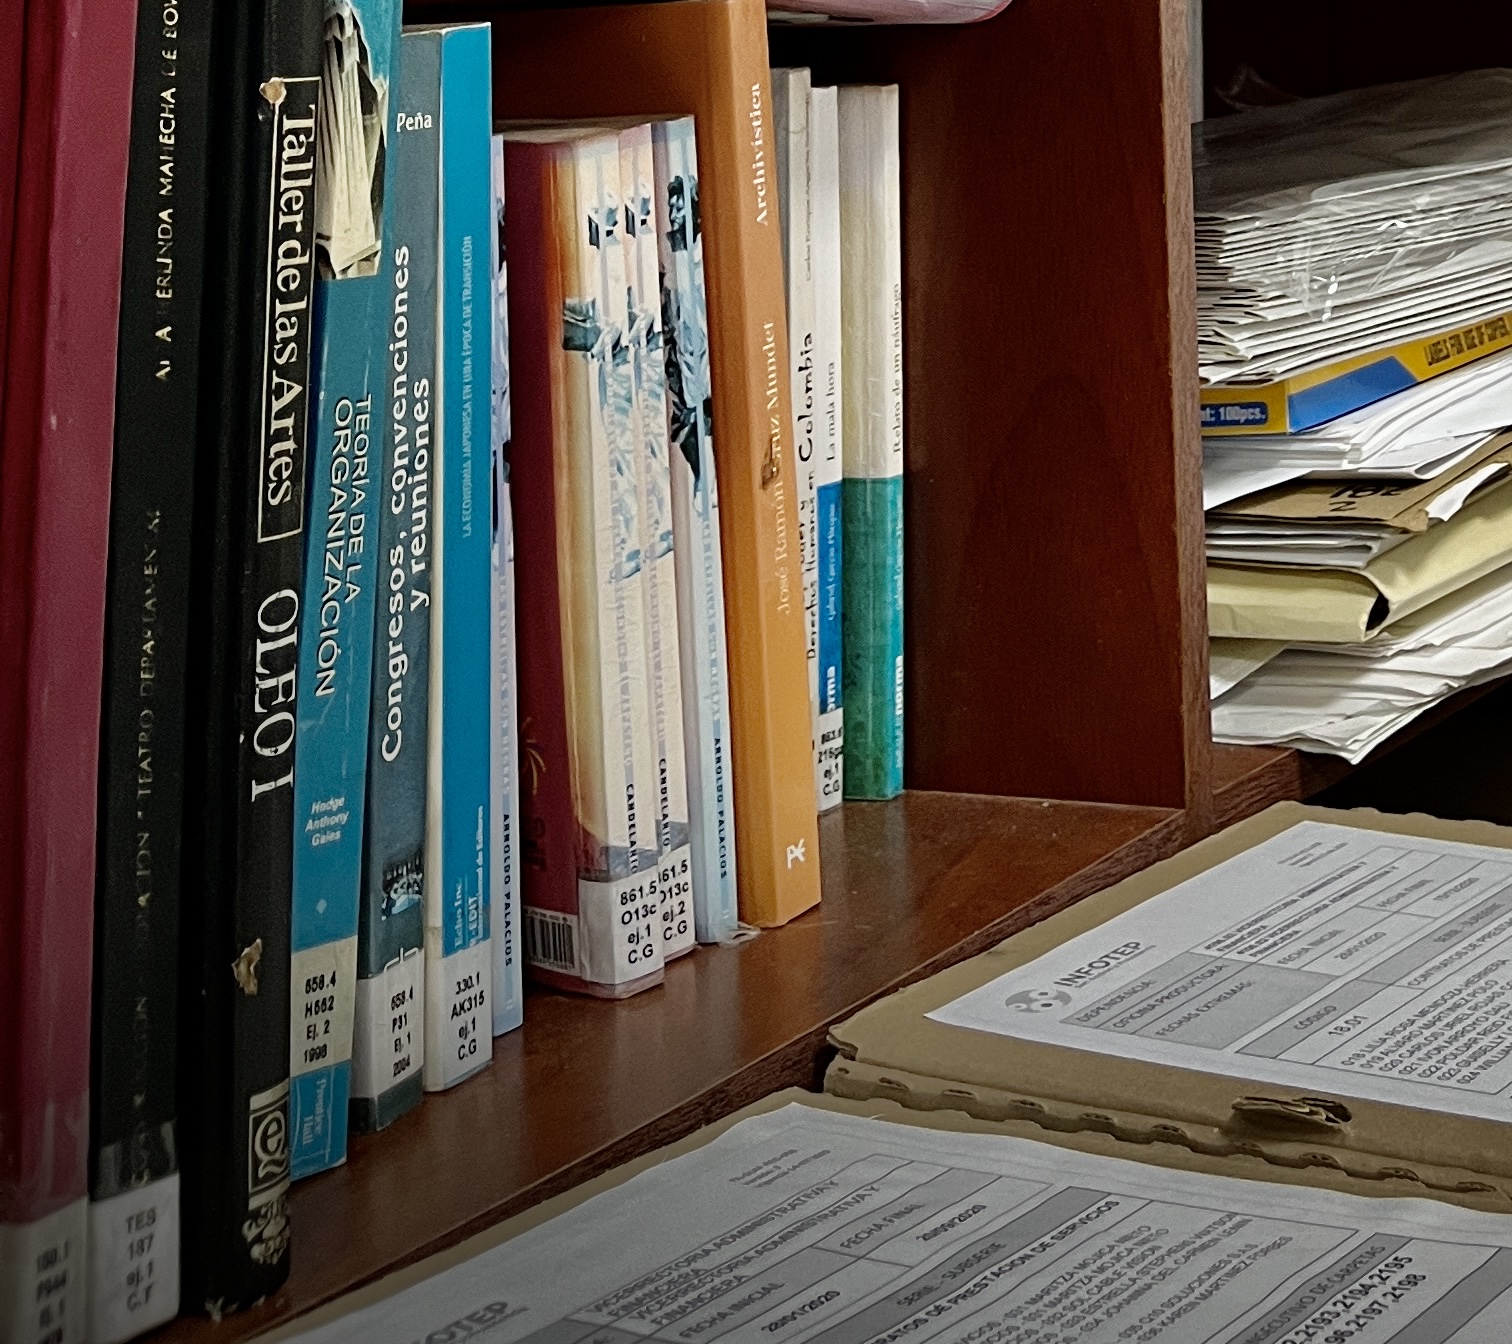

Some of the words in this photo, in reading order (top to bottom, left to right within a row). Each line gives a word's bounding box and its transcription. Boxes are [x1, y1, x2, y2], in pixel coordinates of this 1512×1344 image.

[395, 112, 432, 132] Peña
[274, 105, 317, 232] Taller
[749, 83, 769, 225] Archivística
[276, 235, 307, 295] de
[388, 245, 410, 516] convenciones
[762, 321, 781, 410] Mundet
[826, 362, 837, 397] hora
[798, 332, 815, 462] Colombia
[825, 401, 837, 438] mala
[268, 371, 303, 507] Artes
[352, 393, 373, 504] TEORÍA
[825, 440, 837, 462] La
[408, 378, 431, 573] reuniones
[314, 397, 352, 698] ORGANIZACIÓN
[770, 482, 788, 559] Ramón
[345, 566, 362, 604] LA
[410, 581, 429, 614] y
[775, 567, 792, 615] José
[253, 588, 298, 757] OLEO
[381, 530, 410, 762] Congresos,
[252, 777, 292, 802] I
[714, 737, 723, 799] ARNOLDO
[658, 758, 671, 847] CANDELARIO
[502, 814, 513, 889] ARNOLDO
[718, 801, 728, 879] PALACIOS
[620, 880, 657, 906] 861.5
[662, 901, 686, 924] ej.2
[503, 890, 514, 968] PALACIOS
[627, 927, 652, 945] ej.1
[628, 943, 654, 964] C.G
[663, 921, 688, 943] C.G
[305, 971, 337, 993] 658.4
[455, 972, 480, 996] 330.1
[1053, 941, 1142, 987] INFOTEP
[451, 992, 485, 1021] AK315
[457, 1039, 478, 1061] C.G
